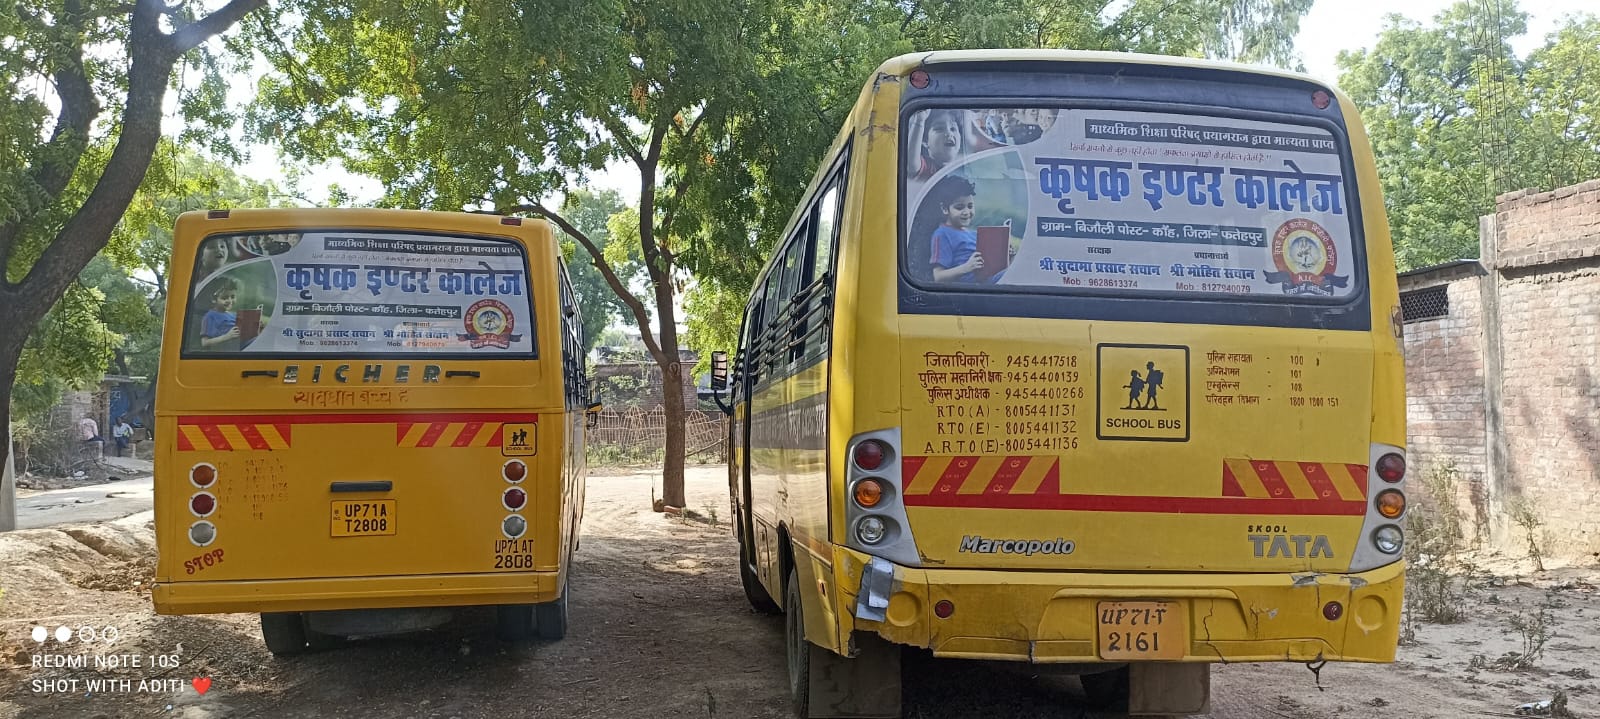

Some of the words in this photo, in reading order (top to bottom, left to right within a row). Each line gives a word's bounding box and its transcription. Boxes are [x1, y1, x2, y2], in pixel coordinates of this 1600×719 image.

[1090, 122, 1137, 136] माध्यमिक
[1141, 125, 1168, 138] शिक्षा
[1203, 130, 1249, 144] प्रयागराज
[1251, 132, 1272, 146] द्वारा
[1274, 135, 1309, 148] मान्यता
[1312, 138, 1335, 150] प्राप्त
[1035, 157, 1132, 214] कृषक
[1138, 163, 1225, 211] इण्टर
[1230, 160, 1343, 214] कालेज
[1075, 220, 1115, 235] बिजौली
[1221, 228, 1263, 247] फतेहपुर
[1039, 257, 1054, 270] श्री
[1056, 260, 1093, 274] सुदामा
[1095, 262, 1126, 274] प्रसाद
[1128, 264, 1161, 276] सचान
[1170, 263, 1185, 276] श्री
[1187, 265, 1221, 278] मोहित
[1223, 268, 1256, 280] सचान
[284, 263, 360, 300] कृषक
[364, 264, 432, 296] इण्टर
[436, 261, 523, 296] कालेज
[1063, 276, 1081, 286] Mob
[1088, 278, 1138, 288] 9628613374
[1176, 282, 1194, 291] Mob
[1006, 355, 1078, 368] 9454417518
[1290, 355, 1304, 366] 100
[283, 364, 442, 384] EICHER
[918, 370, 947, 388] पुलिस
[1290, 370, 1302, 379] 101
[926, 386, 952, 404] पुलिस
[955, 386, 990, 400] अधीक्षक
[1005, 387, 1084, 400] 9454400268
[1328, 398, 1339, 408] 151
[1005, 404, 1076, 418] 8005441131
[1006, 420, 1077, 434] 8005441132
[1106, 418, 1154, 429] SCHOOL
[1157, 419, 1182, 430] BUS
[345, 504, 386, 517] UP71A
[345, 519, 386, 532] T2808
[1247, 525, 1288, 533] SKOOL
[495, 540, 518, 554] UP71
[522, 539, 534, 553] AT
[959, 535, 1076, 557] Marcopolo
[1248, 534, 1335, 558] TATA
[184, 548, 225, 575] STOP
[494, 554, 532, 568] 2808
[1108, 631, 1159, 652] 2161
